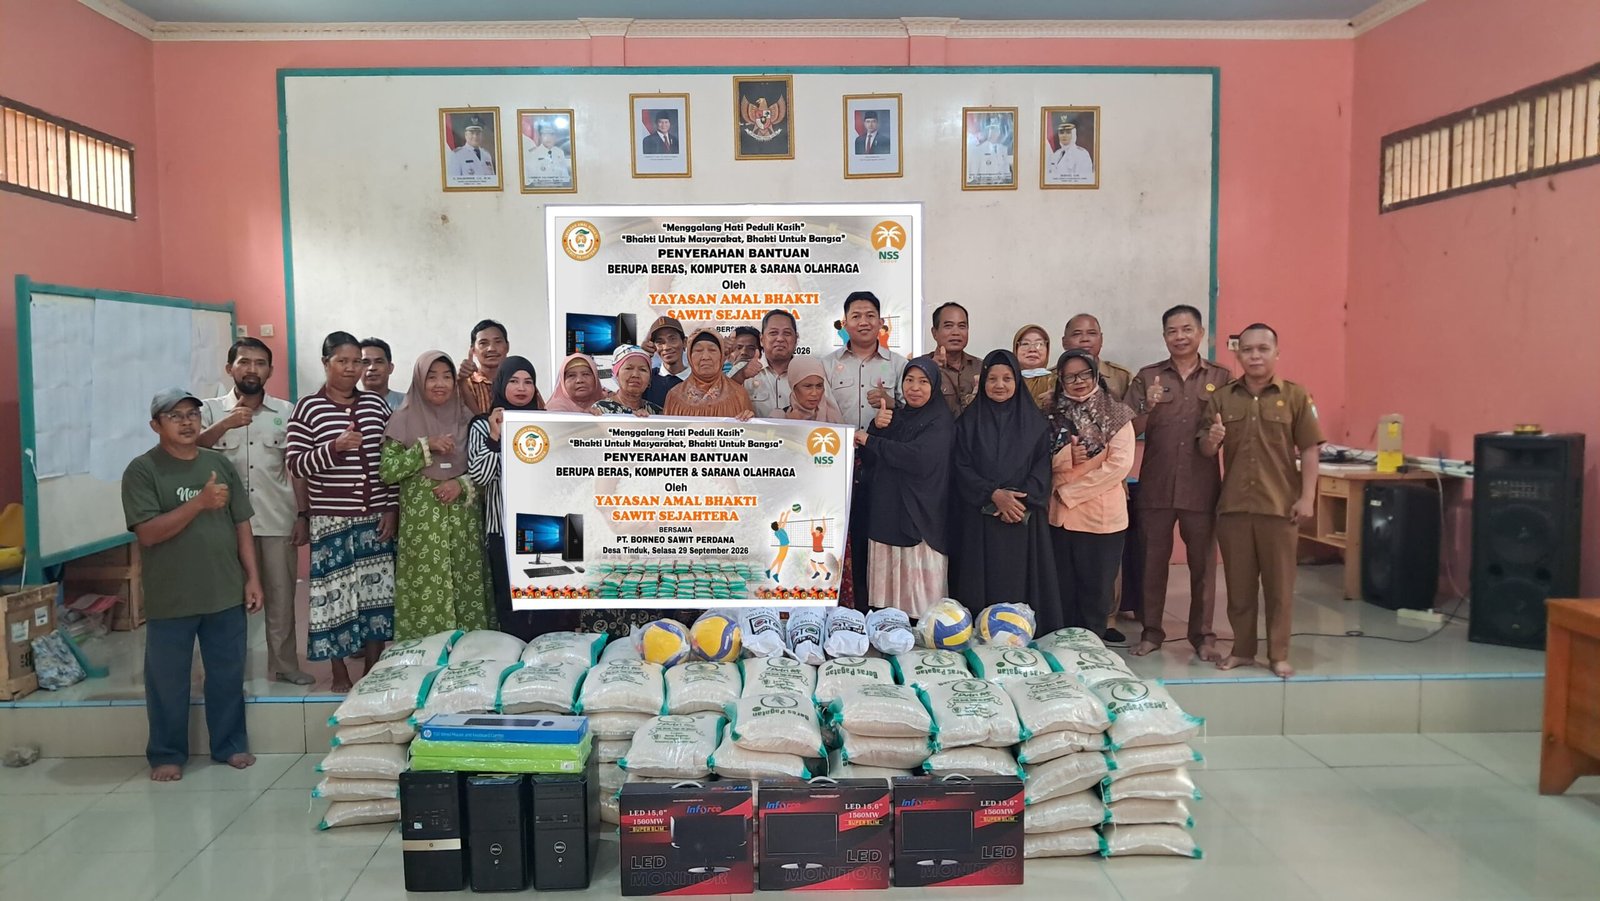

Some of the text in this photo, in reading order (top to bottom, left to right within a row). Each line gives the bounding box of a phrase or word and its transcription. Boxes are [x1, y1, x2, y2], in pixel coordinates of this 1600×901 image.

[662, 223, 805, 233] "Menggalang Hati Peduli Kasih"
[621, 234, 846, 244] "Bhakti Untuk Masyarakat, Bhakti Untuk Bangsa"
[658, 248, 810, 258] PENYERAHAN BANTUAN
[878, 251, 899, 260] NSS
[607, 264, 860, 275] BERUPA BERAS, KOMPUTER & SARANA OLAHRAGA
[721, 280, 746, 290] Oleh
[649, 294, 820, 305] YAYASAN AMAL BHAKTI
[667, 309, 800, 320] SAWIT SEJAHTA
[608, 428, 744, 437] "Menggalang Hati Peduli Kasih"
[569, 439, 783, 449] "Bhakti Untuk Masyarakat, Bhakti Untuk Bangsa"
[603, 452, 748, 462] PENYERAHAN BANTUAN
[814, 456, 834, 465] NSS
[555, 467, 796, 478] BERUPA BERAS, KOMPUTER & SARANA OLAHRAGA
[664, 482, 688, 492] Oleh
[595, 495, 757, 506] YAYASAN AMAL BHAKTI
[612, 511, 739, 521] SAWIT SEJAHTERA
[616, 536, 735, 544] PT. BORNEO SAWIT PERDANA
[622, 547, 650, 555] Tinduk,
[689, 547, 729, 556] September
[825, 667, 855, 677] Pagatan
[916, 667, 946, 676] Pagatan
[752, 707, 785, 718] Pagatan
[846, 849, 883, 864] LED
[981, 845, 1018, 860] LED
[630, 855, 667, 870] LED
[785, 866, 881, 881] MONITOR
[921, 862, 1018, 878] MONITOR
[630, 871, 728, 887] MONITOR
